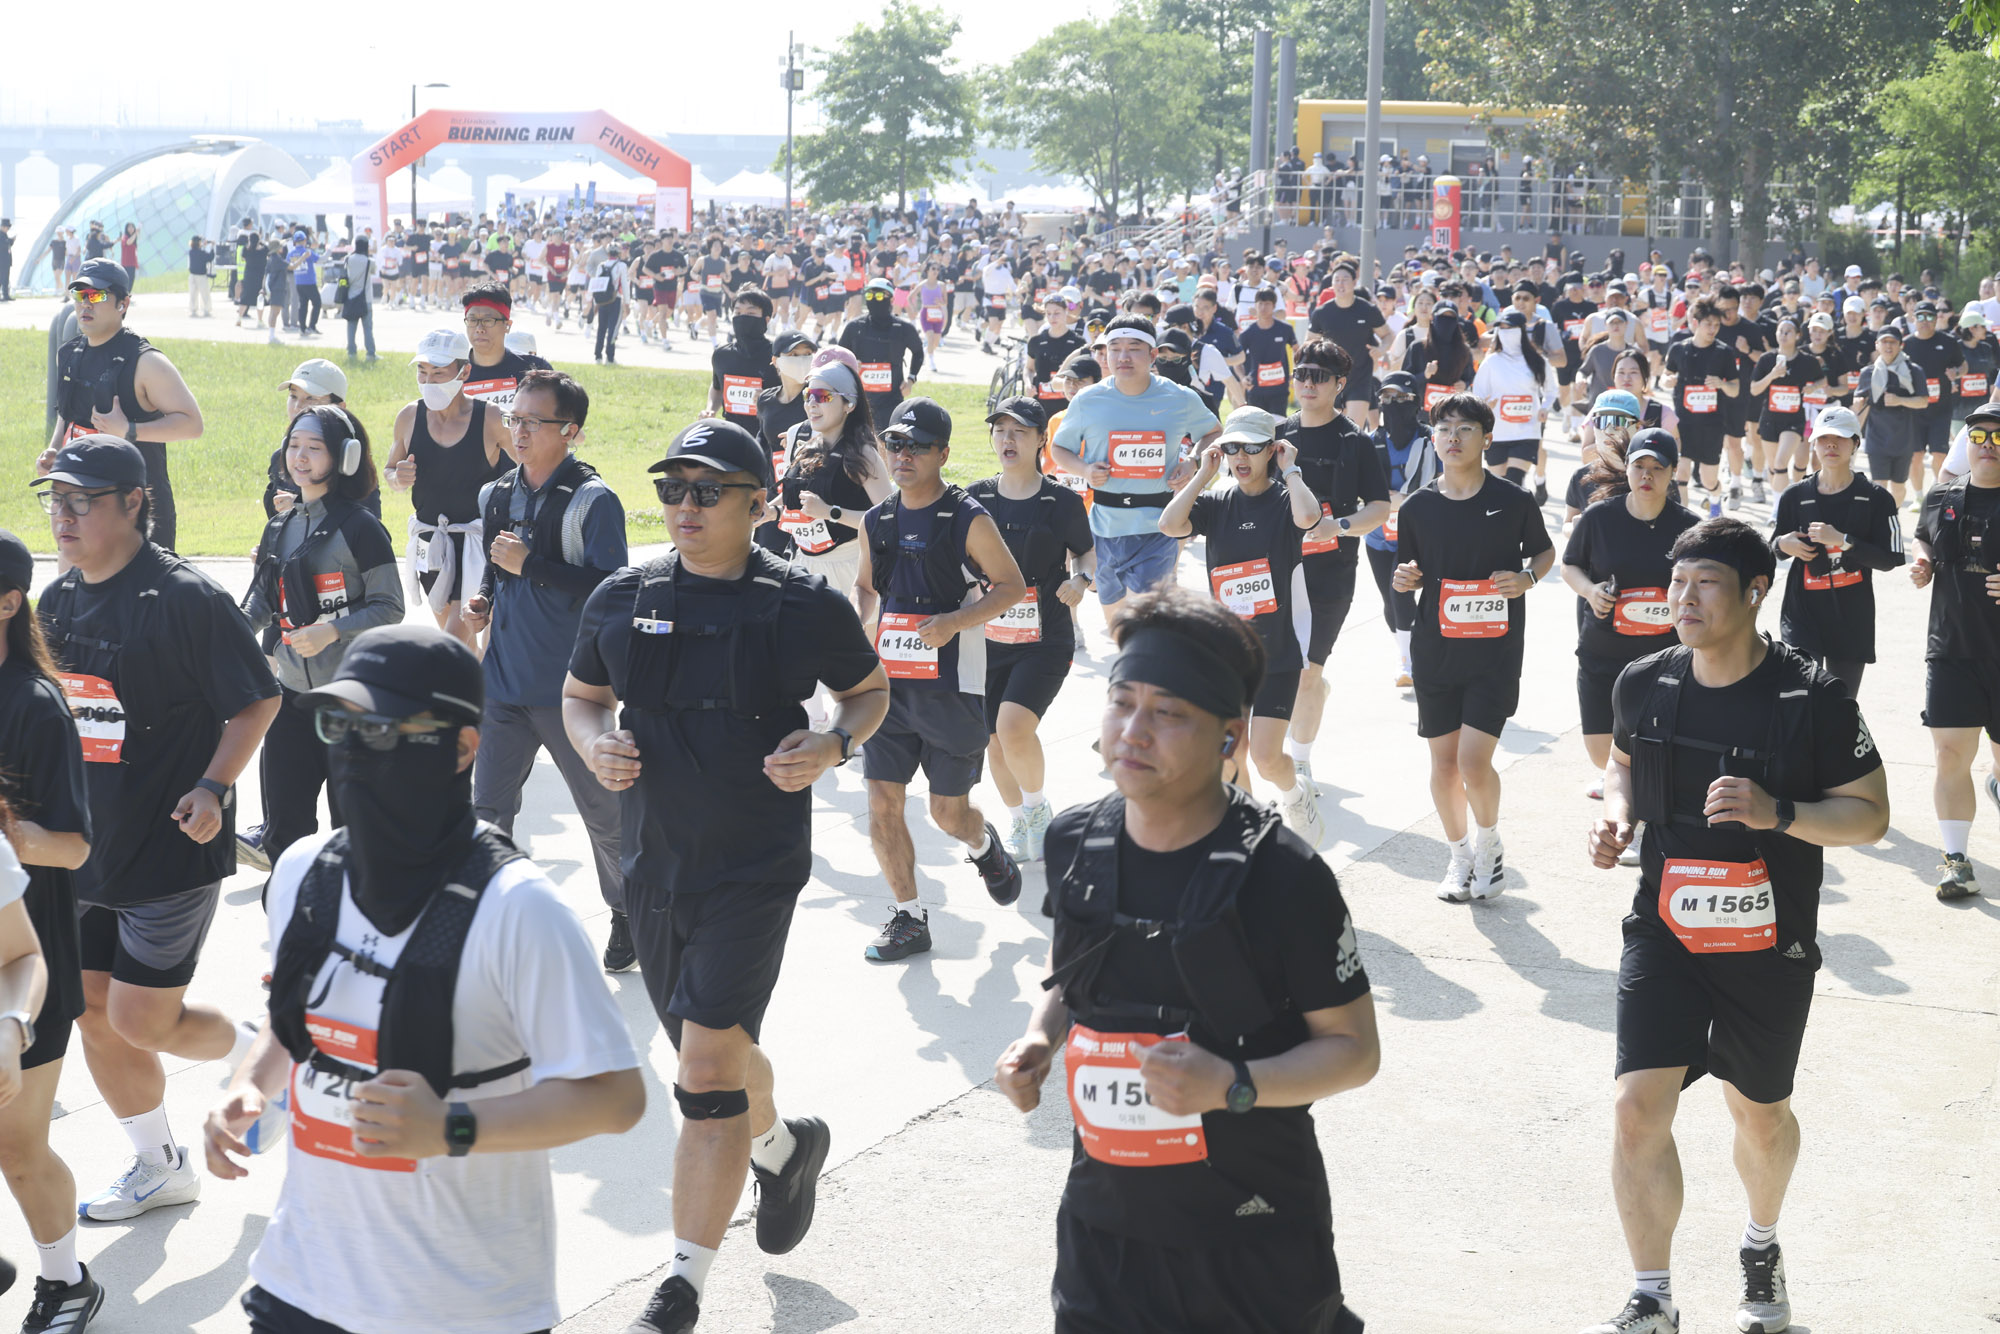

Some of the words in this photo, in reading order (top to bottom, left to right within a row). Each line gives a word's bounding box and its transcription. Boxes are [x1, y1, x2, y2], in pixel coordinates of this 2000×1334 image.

[447, 126, 530, 141] BURNING
[535, 127, 575, 141] RUN
[369, 125, 422, 167] START
[599, 126, 660, 170] FINISH
[820, 354, 828, 362] C
[487, 394, 515, 404] 442
[1119, 450, 1127, 458] M
[1131, 448, 1163, 458] 1664
[795, 523, 825, 537] 4513
[1224, 587, 1233, 597] W
[1236, 578, 1270, 595] 3960
[1450, 603, 1460, 612] M
[1465, 600, 1504, 612] 1738
[1007, 607, 1036, 619] 958
[882, 638, 890, 648] M
[1668, 865, 1707, 875] BURNING
[1707, 867, 1729, 876] RUN
[1747, 868, 1764, 877] 10km
[1681, 898, 1698, 911] M
[1706, 890, 1769, 913] 1565
[1102, 1042, 1126, 1053] RUN
[1083, 1084, 1097, 1102] M
